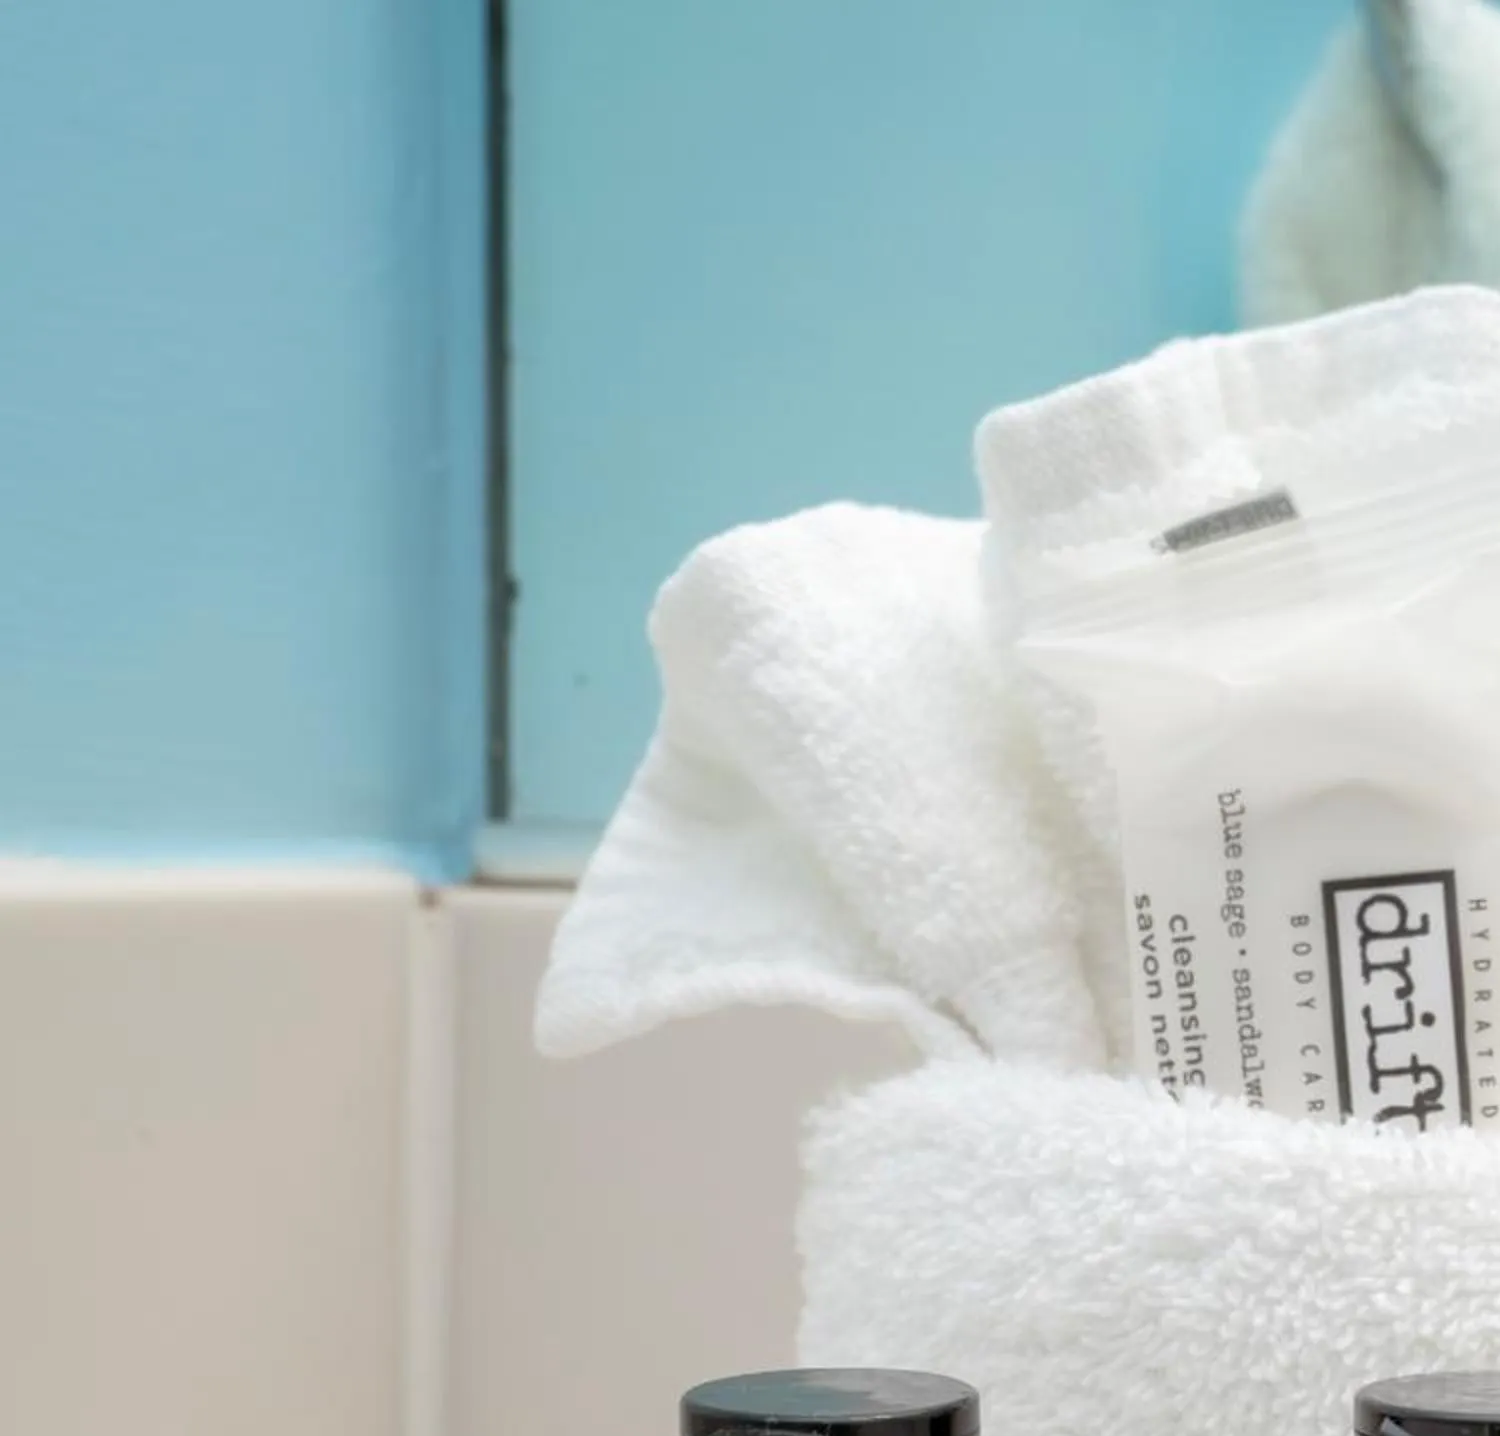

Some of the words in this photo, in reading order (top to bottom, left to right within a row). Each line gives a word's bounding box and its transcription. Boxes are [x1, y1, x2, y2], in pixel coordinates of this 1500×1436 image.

[1218, 787, 1244, 859] blue
[1134, 894, 1163, 999] savon
[1220, 869, 1247, 938] sage
[1169, 914, 1208, 1087] cleansing
[1290, 915, 1317, 1009] BODY
[1468, 898, 1499, 1117] HYDRATED
[1356, 893, 1445, 1132] drift
[1301, 1045, 1325, 1112] CAR
